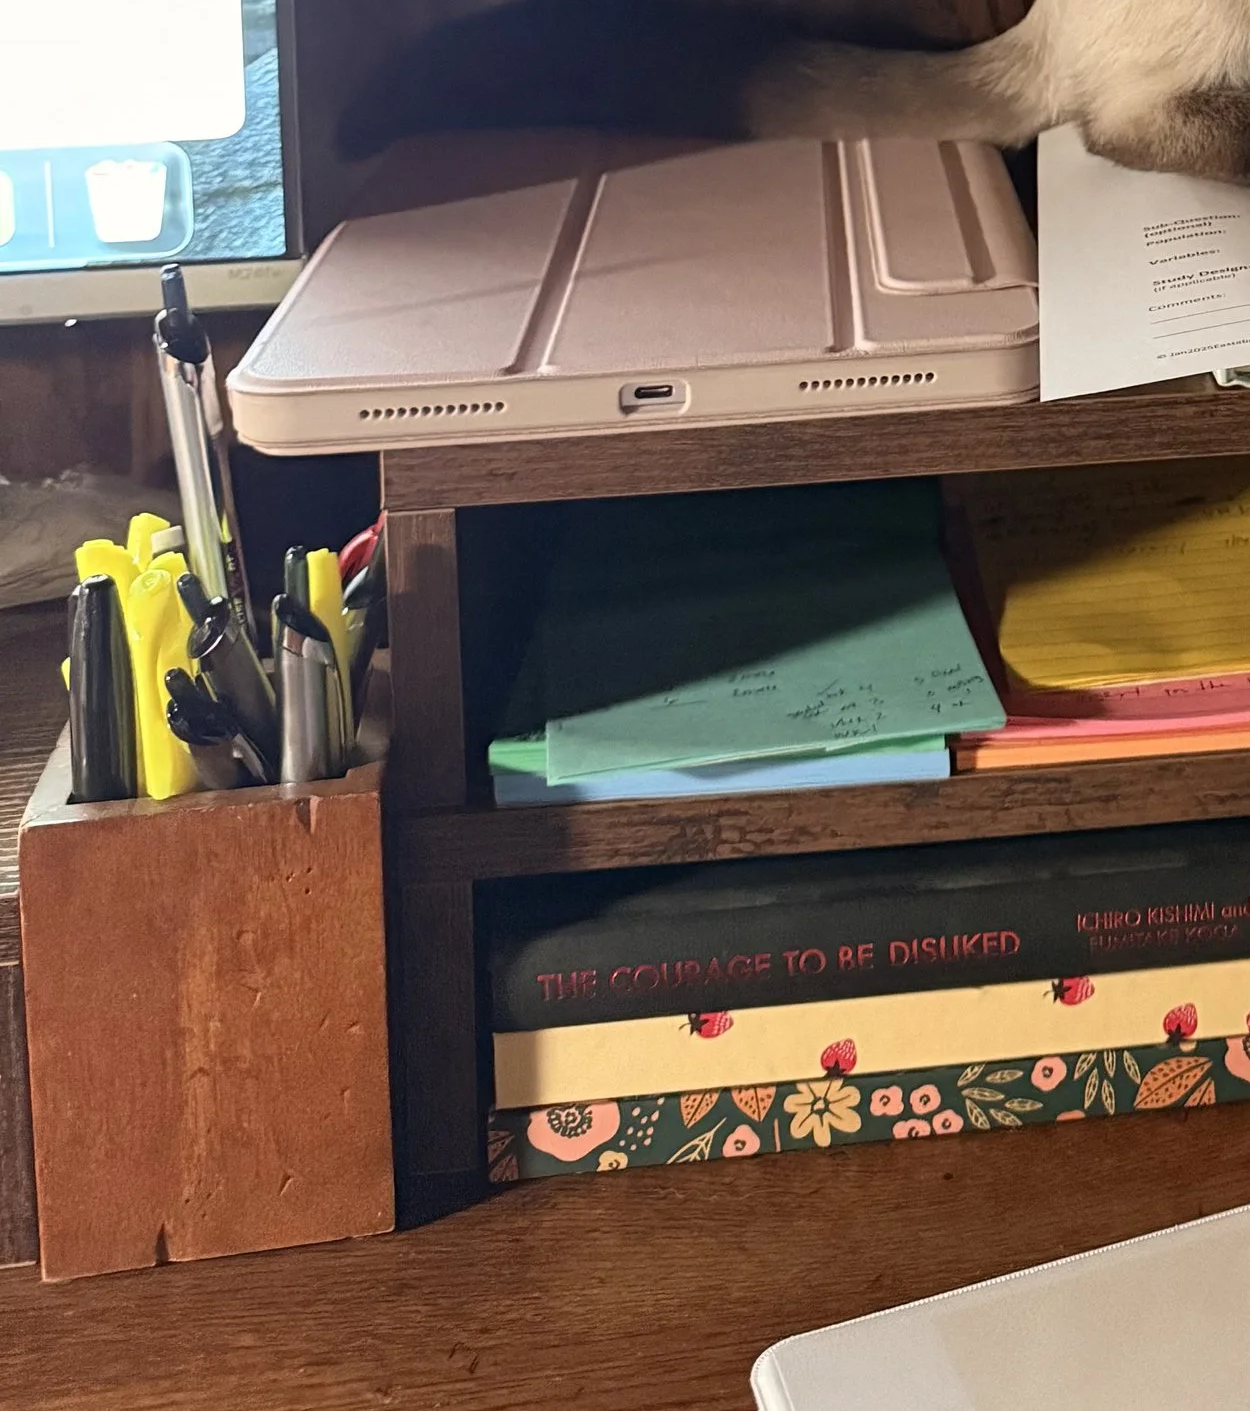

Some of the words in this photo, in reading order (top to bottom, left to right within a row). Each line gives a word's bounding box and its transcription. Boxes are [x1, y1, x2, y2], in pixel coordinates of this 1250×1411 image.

[1144, 222, 1213, 238] (optional)
[1148, 249, 1222, 266] Variables:
[1152, 273, 1195, 286] Study
[1169, 273, 1236, 290] applicable)
[1148, 293, 1227, 312] Comments:
[1076, 908, 1141, 932] ICHIRO
[1147, 901, 1215, 926] KISHIMI
[537, 969, 597, 1002] THE
[607, 952, 772, 991] COURAGE
[782, 947, 827, 976] TO
[839, 942, 874, 972] BE
[888, 930, 1021, 966] DISLIKED
